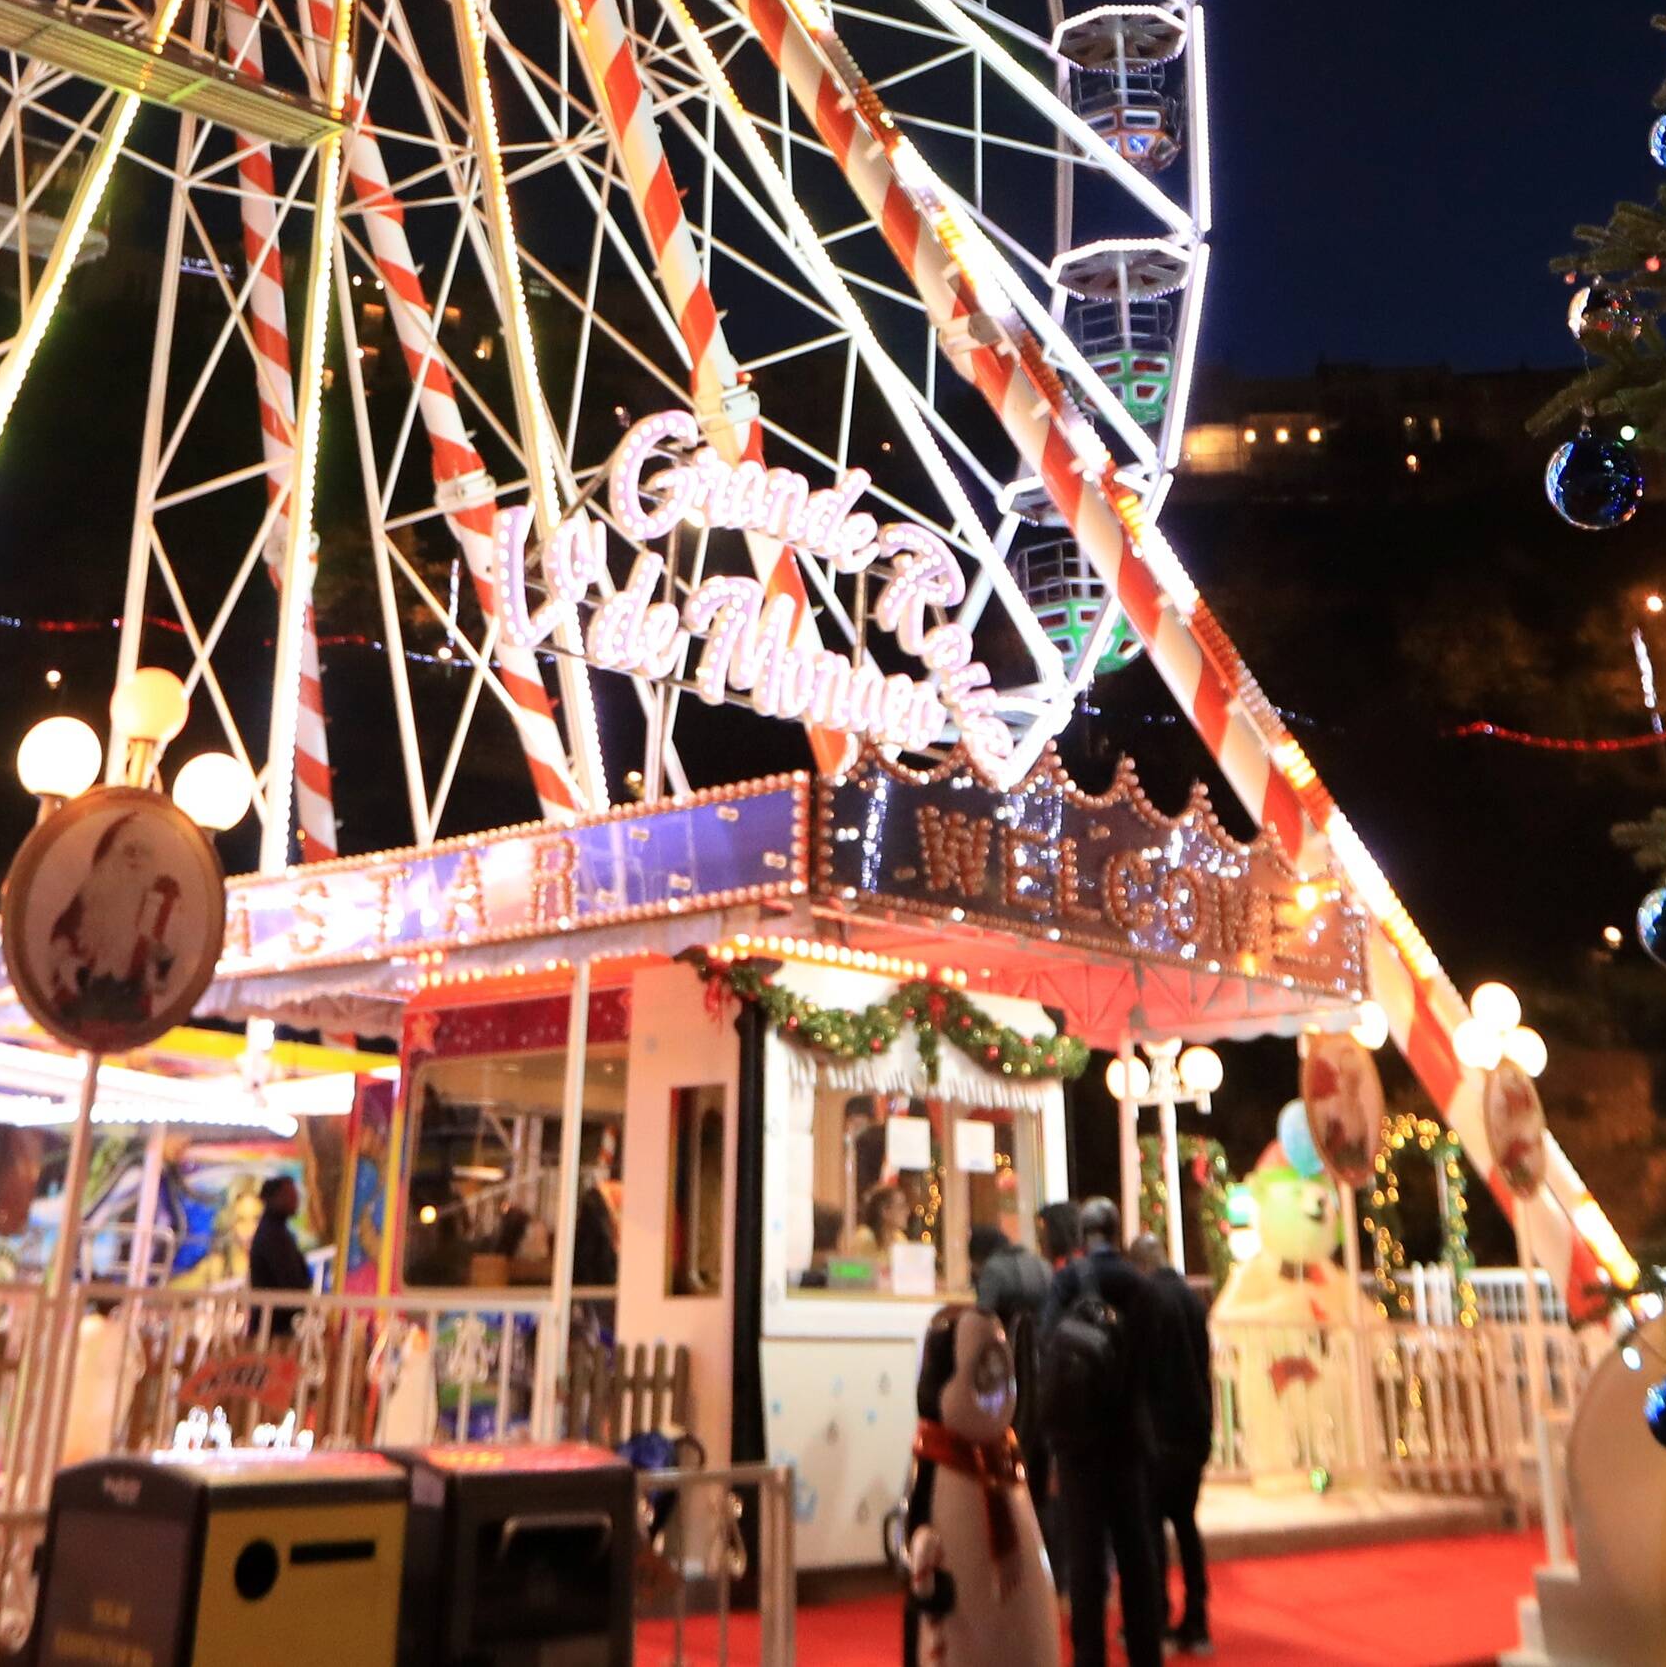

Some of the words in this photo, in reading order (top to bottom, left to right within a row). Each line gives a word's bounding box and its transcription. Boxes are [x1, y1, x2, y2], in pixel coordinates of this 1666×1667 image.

[492, 503, 607, 647] La
[609, 409, 881, 574] Grande
[876, 522, 1015, 776] Roue
[587, 551, 690, 679] de
[915, 804, 1331, 967] WELCOME
